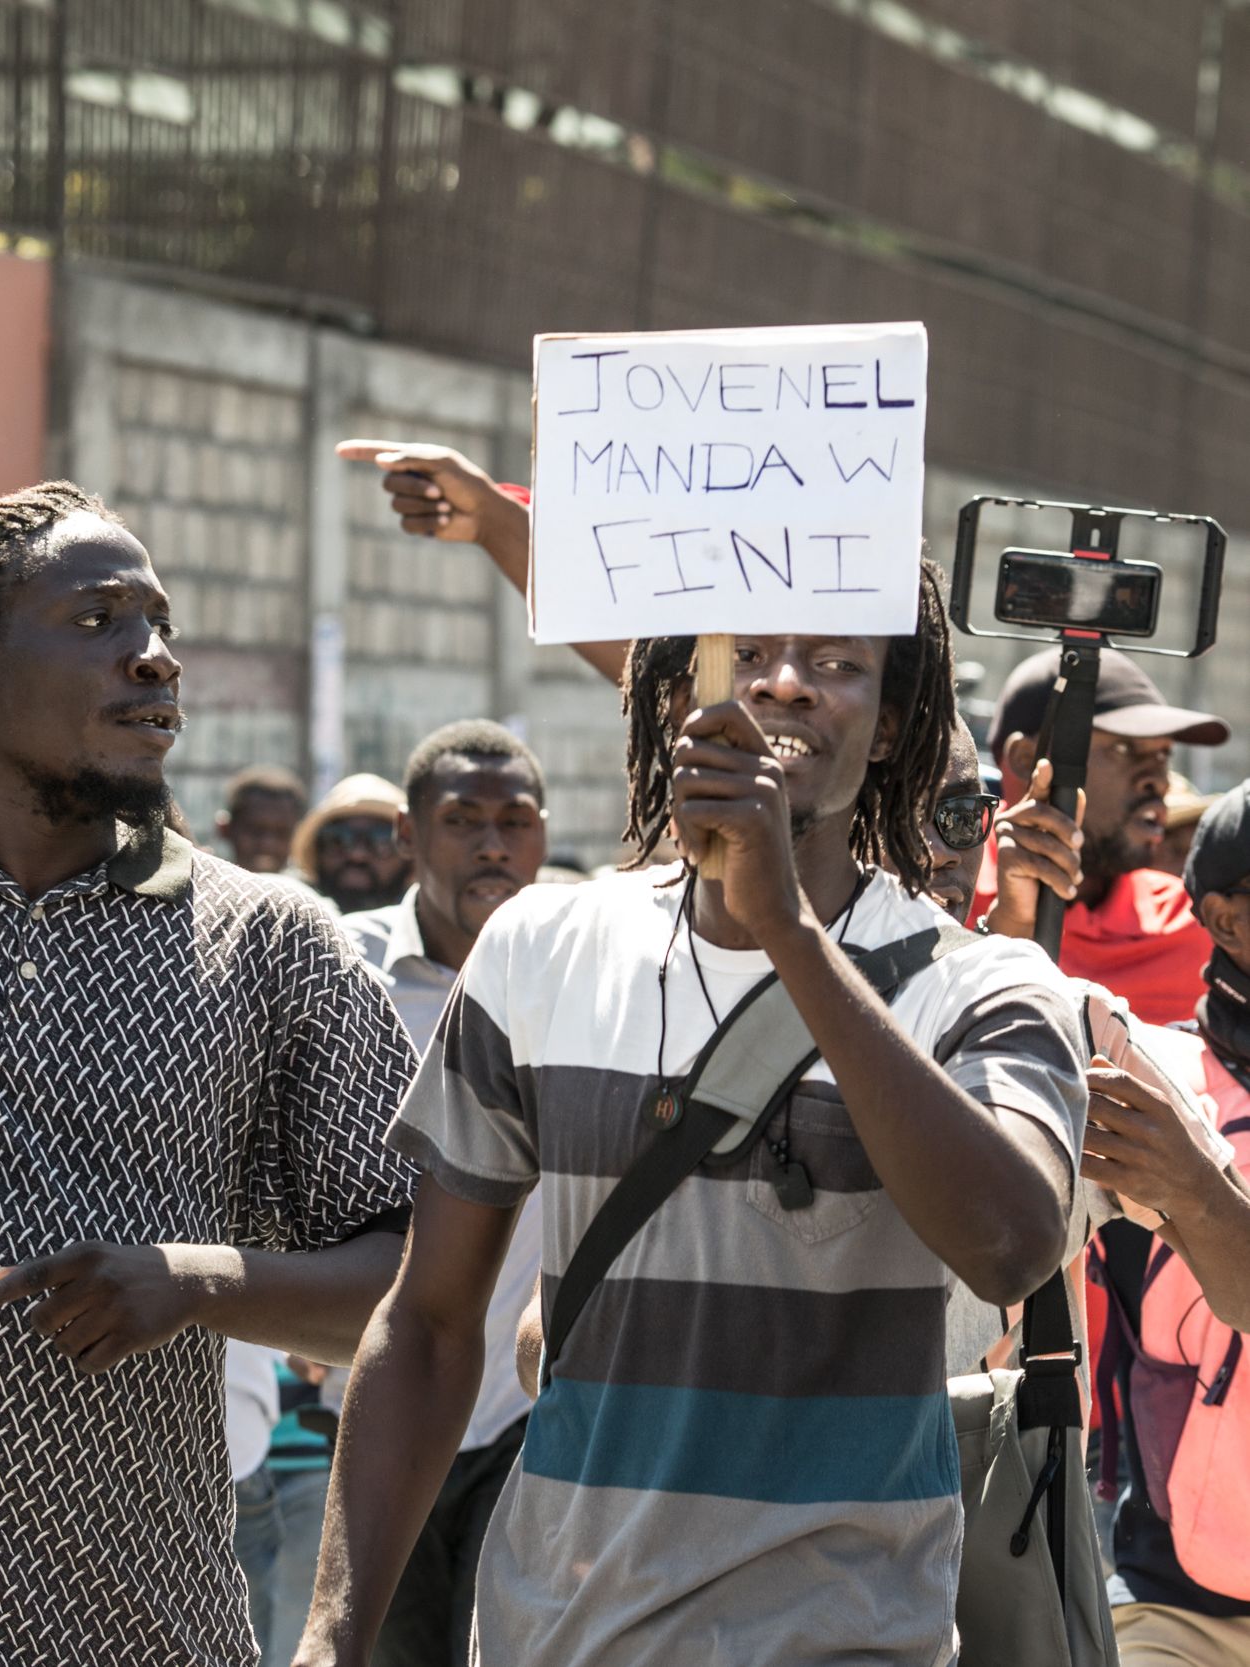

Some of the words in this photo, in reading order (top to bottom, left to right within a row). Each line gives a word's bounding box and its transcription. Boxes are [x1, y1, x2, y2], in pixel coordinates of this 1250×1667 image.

[558, 350, 915, 416] JOVENEL
[573, 440, 804, 496] MANDA
[828, 437, 899, 483] W
[592, 518, 881, 604] FINI
